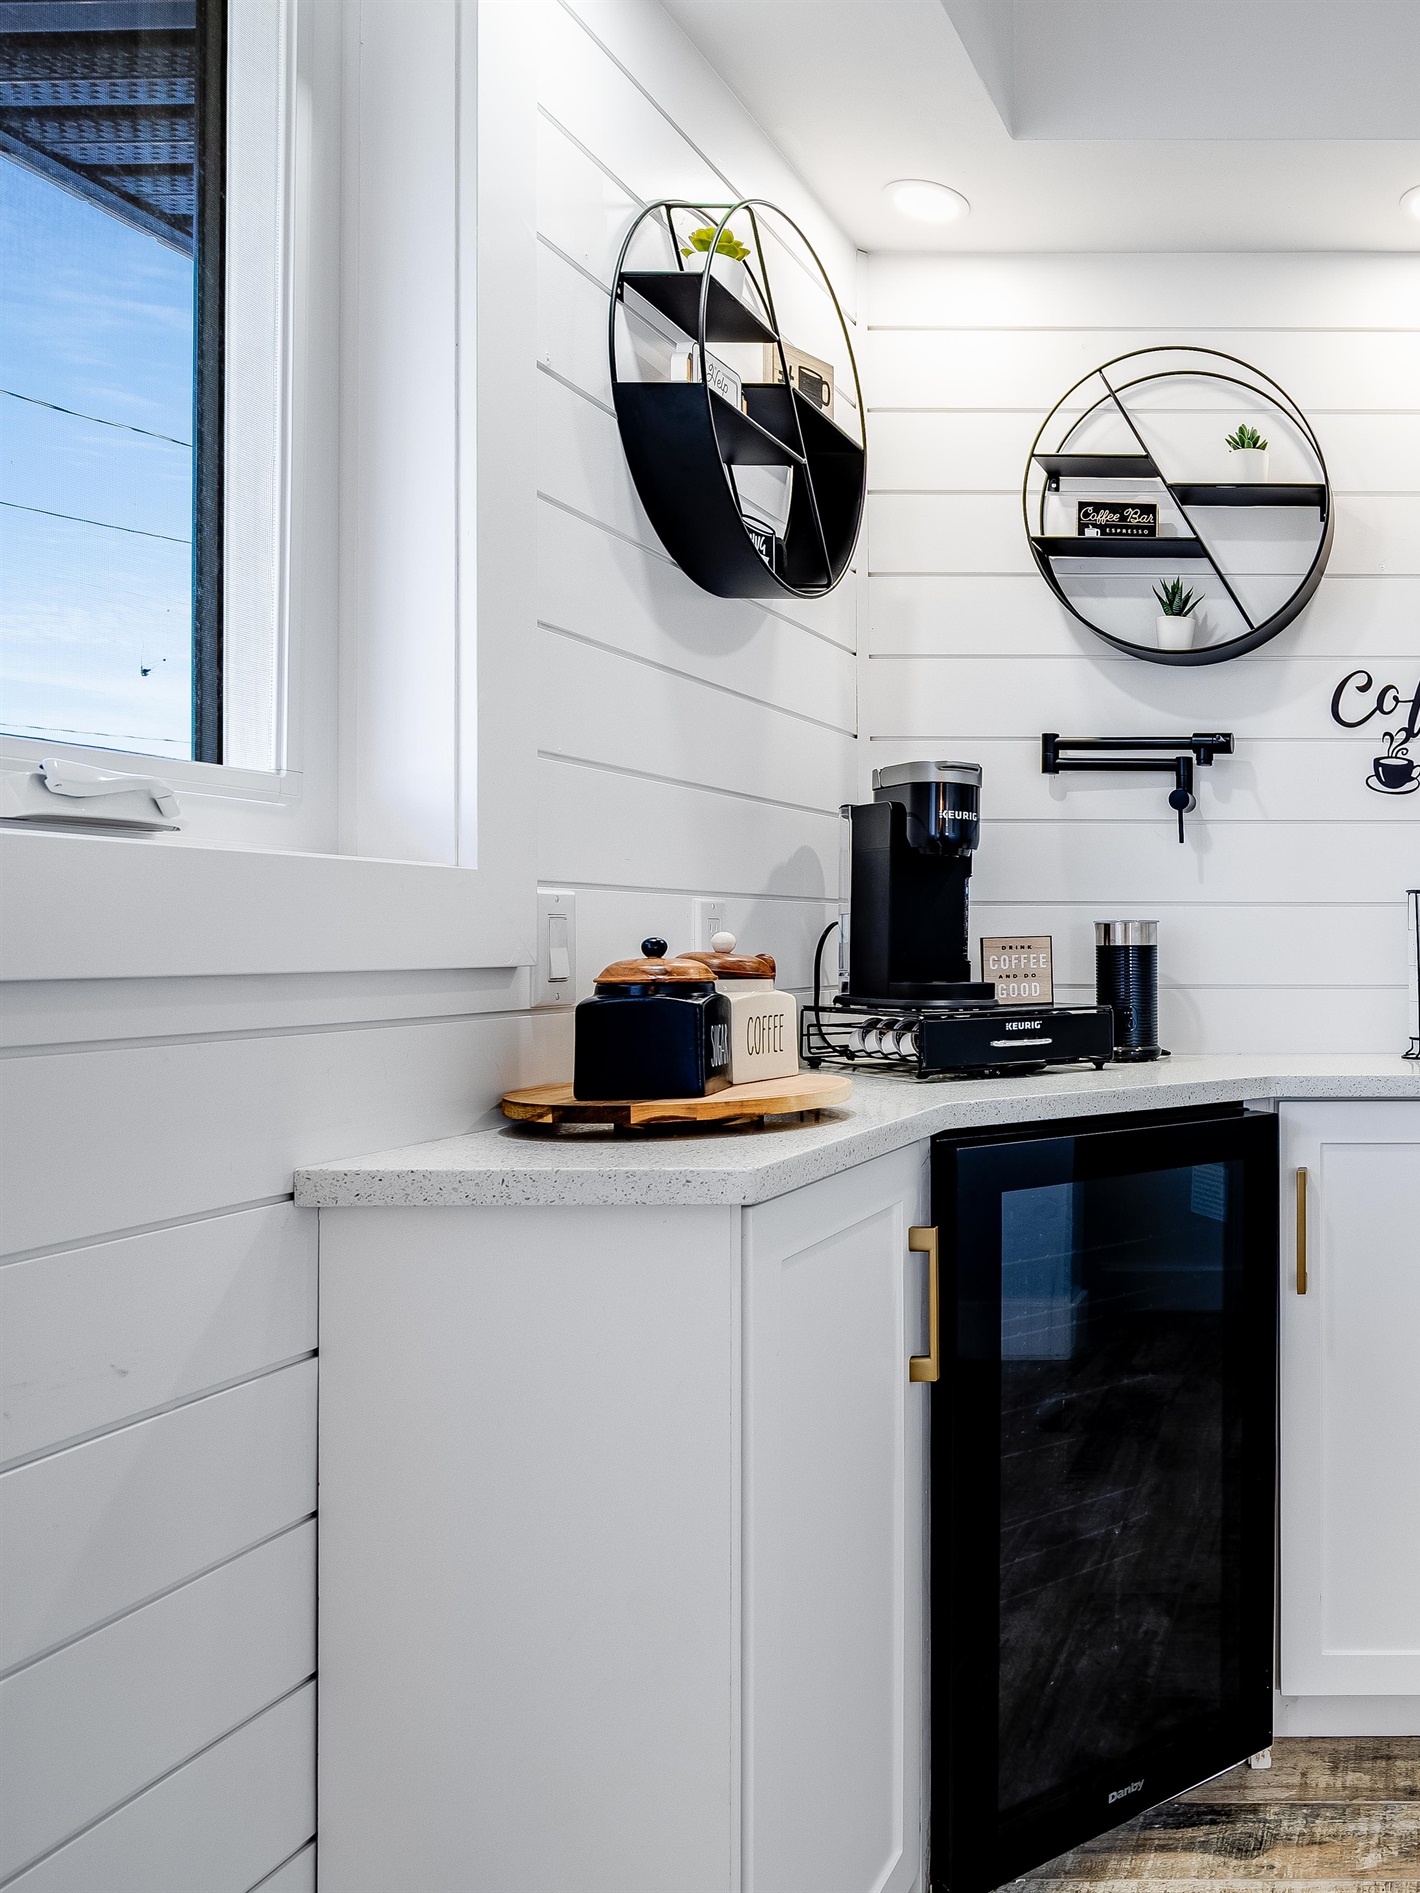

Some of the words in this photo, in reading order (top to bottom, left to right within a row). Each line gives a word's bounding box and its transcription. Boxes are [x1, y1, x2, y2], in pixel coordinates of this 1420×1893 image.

[1080, 506, 1120, 524] Coffee
[1123, 507, 1155, 524] Bar
[1106, 527, 1149, 535] ESPRESSO
[939, 810, 978, 821] KEURIG
[989, 953, 1047, 970] COFFEE
[998, 982, 1040, 998] GOOD
[1005, 1021, 1041, 1030] KEURIG
[746, 1013, 784, 1056] COFFEE
[1108, 1779, 1145, 1804] Danby
